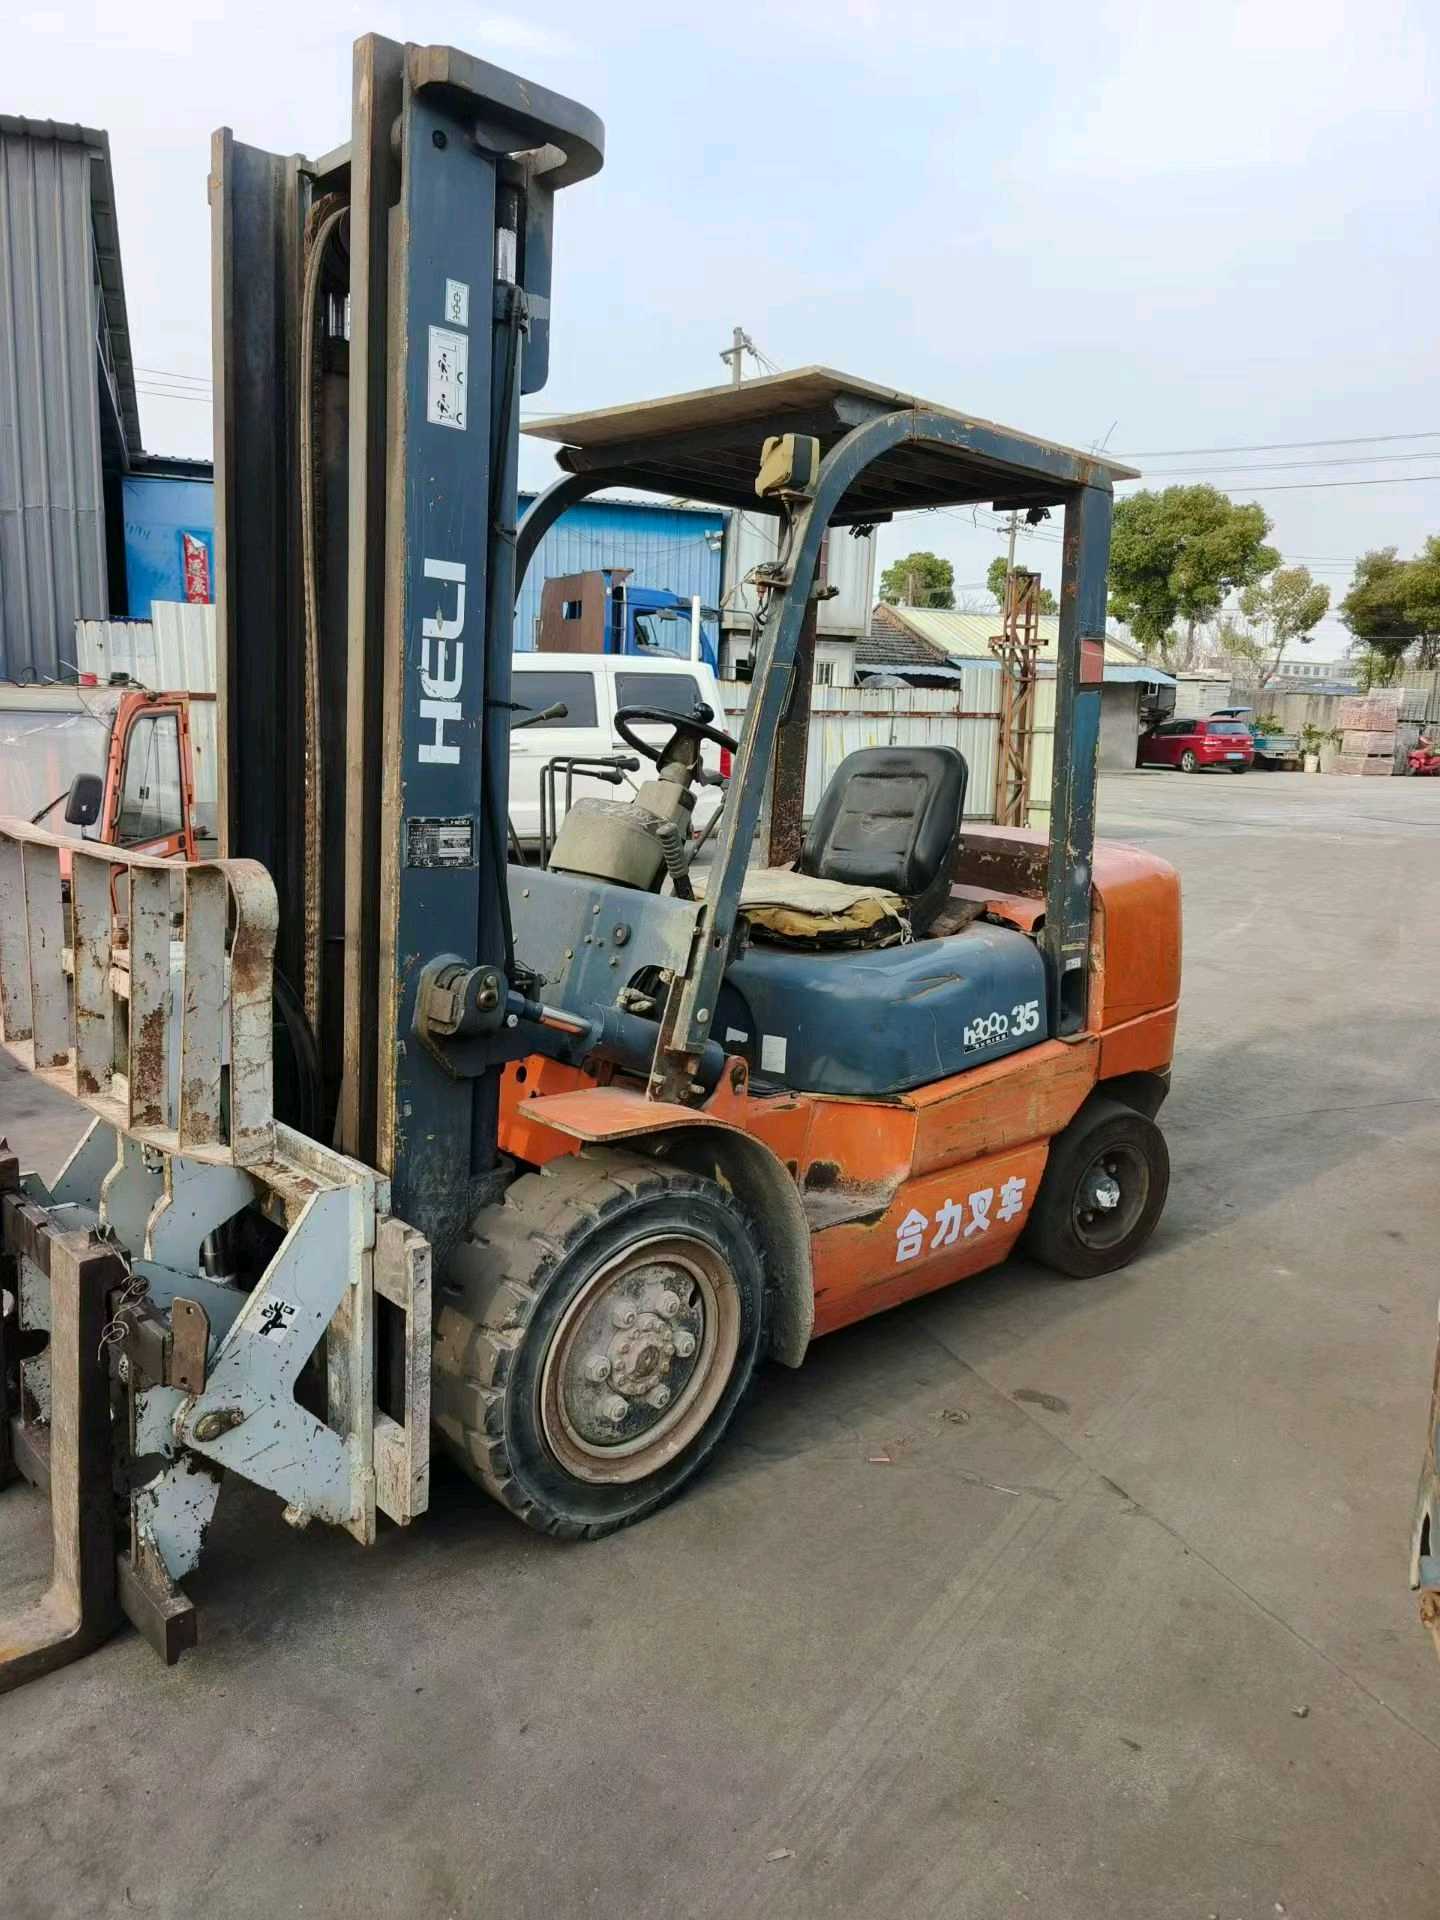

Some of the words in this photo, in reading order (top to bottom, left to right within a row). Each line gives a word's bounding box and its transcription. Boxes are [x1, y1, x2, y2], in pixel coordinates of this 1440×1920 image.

[418, 558, 466, 764] HELI
[1011, 1000, 1039, 1036] 35
[896, 1176, 1026, 1262] 合力叉车
